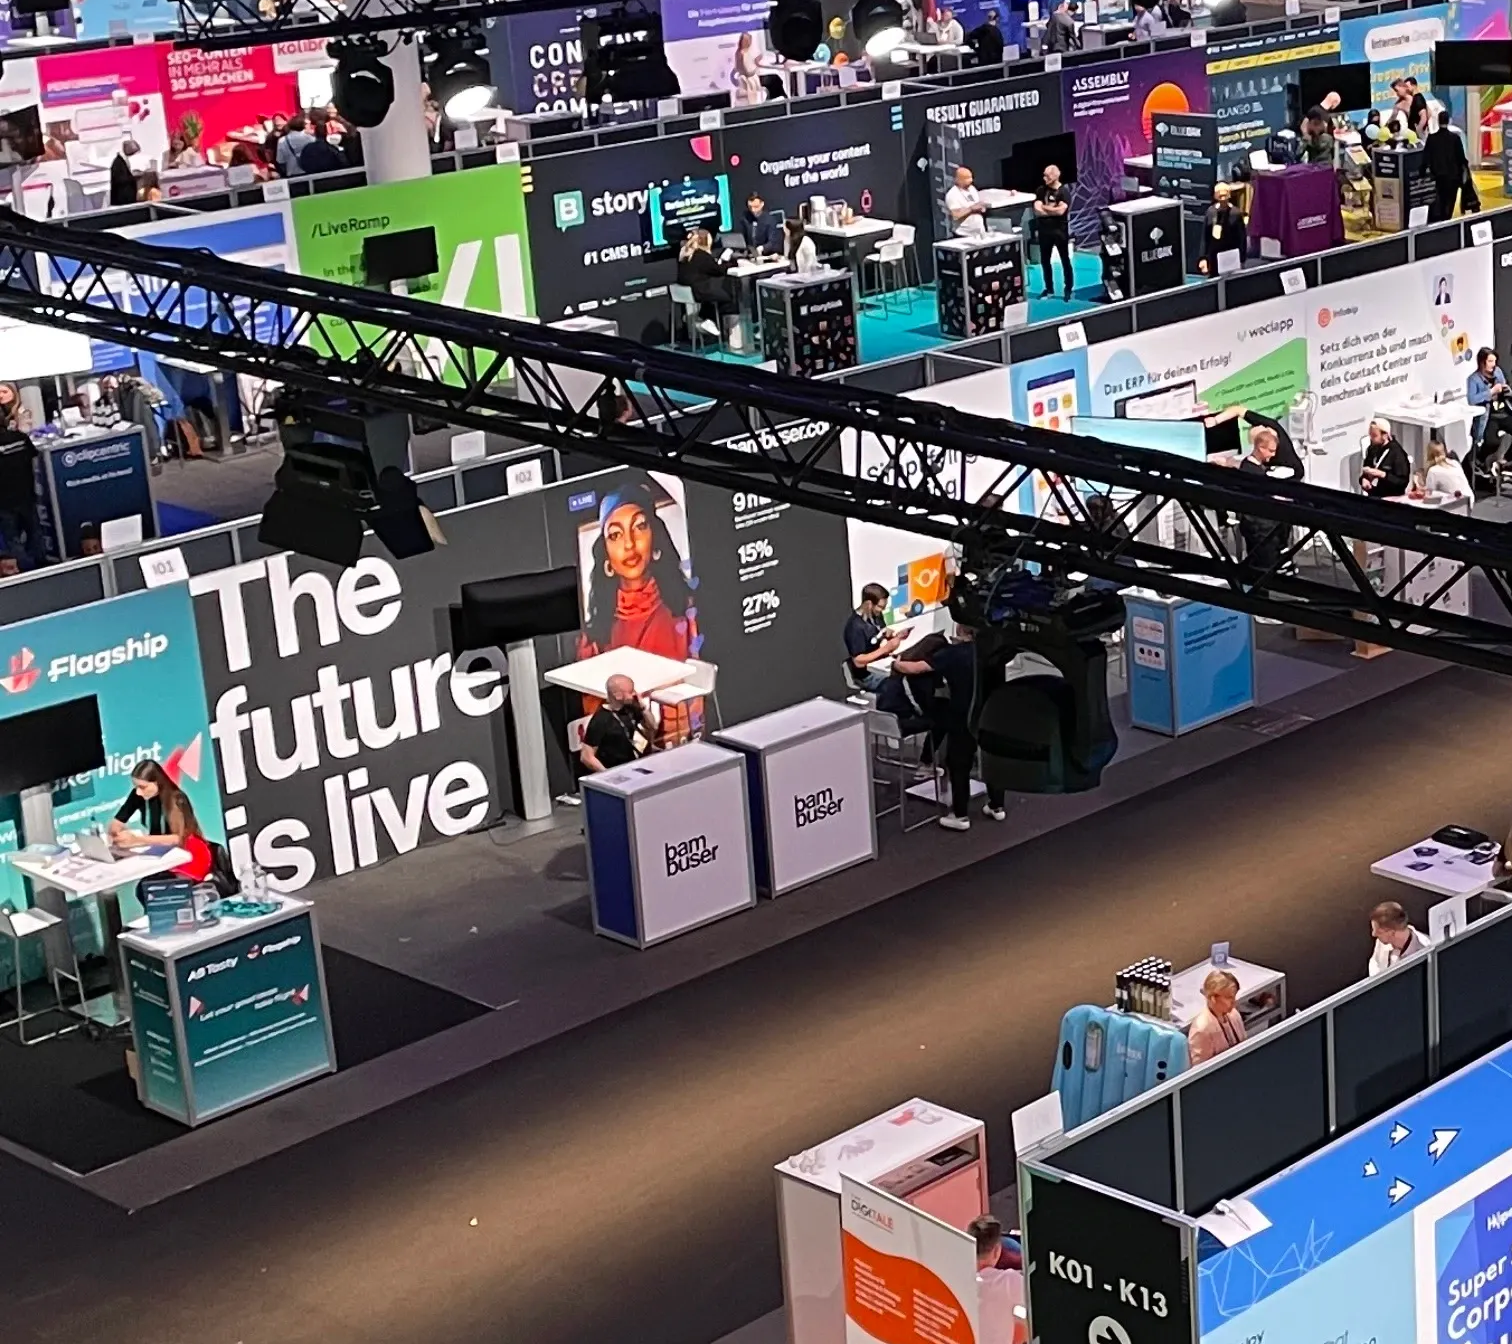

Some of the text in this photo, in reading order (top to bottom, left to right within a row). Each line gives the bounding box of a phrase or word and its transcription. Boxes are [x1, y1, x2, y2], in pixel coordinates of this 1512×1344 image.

[171, 69, 254, 92] 30 SPRACHEN
[183, 60, 220, 76] MEHR
[221, 58, 244, 71] ALS
[1072, 71, 1130, 92] ASSEMBLY
[926, 90, 1040, 123] RESULT GUARANTEED
[760, 142, 871, 177] Organize your content
[784, 162, 850, 188] for the world
[591, 187, 652, 217] story
[601, 245, 628, 262] CMS
[629, 243, 642, 258] in
[1249, 318, 1294, 338] weclapp
[1320, 326, 1397, 356] Setz dich von der
[1320, 332, 1433, 372] Konkurrenz ab und mach
[1104, 351, 1233, 397] Das ERP für deinen Erfolg!
[1320, 350, 1428, 390] dein Contact Center zur
[1321, 383, 1372, 406] Benchmark
[1373, 372, 1409, 391] anderer
[738, 539, 774, 564] 15%
[188, 554, 403, 674] The
[743, 589, 781, 617] 27%
[47, 630, 169, 683] Flagship
[210, 644, 510, 795] future
[794, 787, 834, 811] bam
[795, 796, 845, 828] buser
[228, 806, 316, 894] is
[323, 761, 490, 876] live
[664, 834, 707, 859] bam
[666, 844, 719, 877] buser
[1048, 1251, 1095, 1292] K01
[1119, 1276, 1170, 1318] K13
[1448, 1255, 1508, 1307] Super
